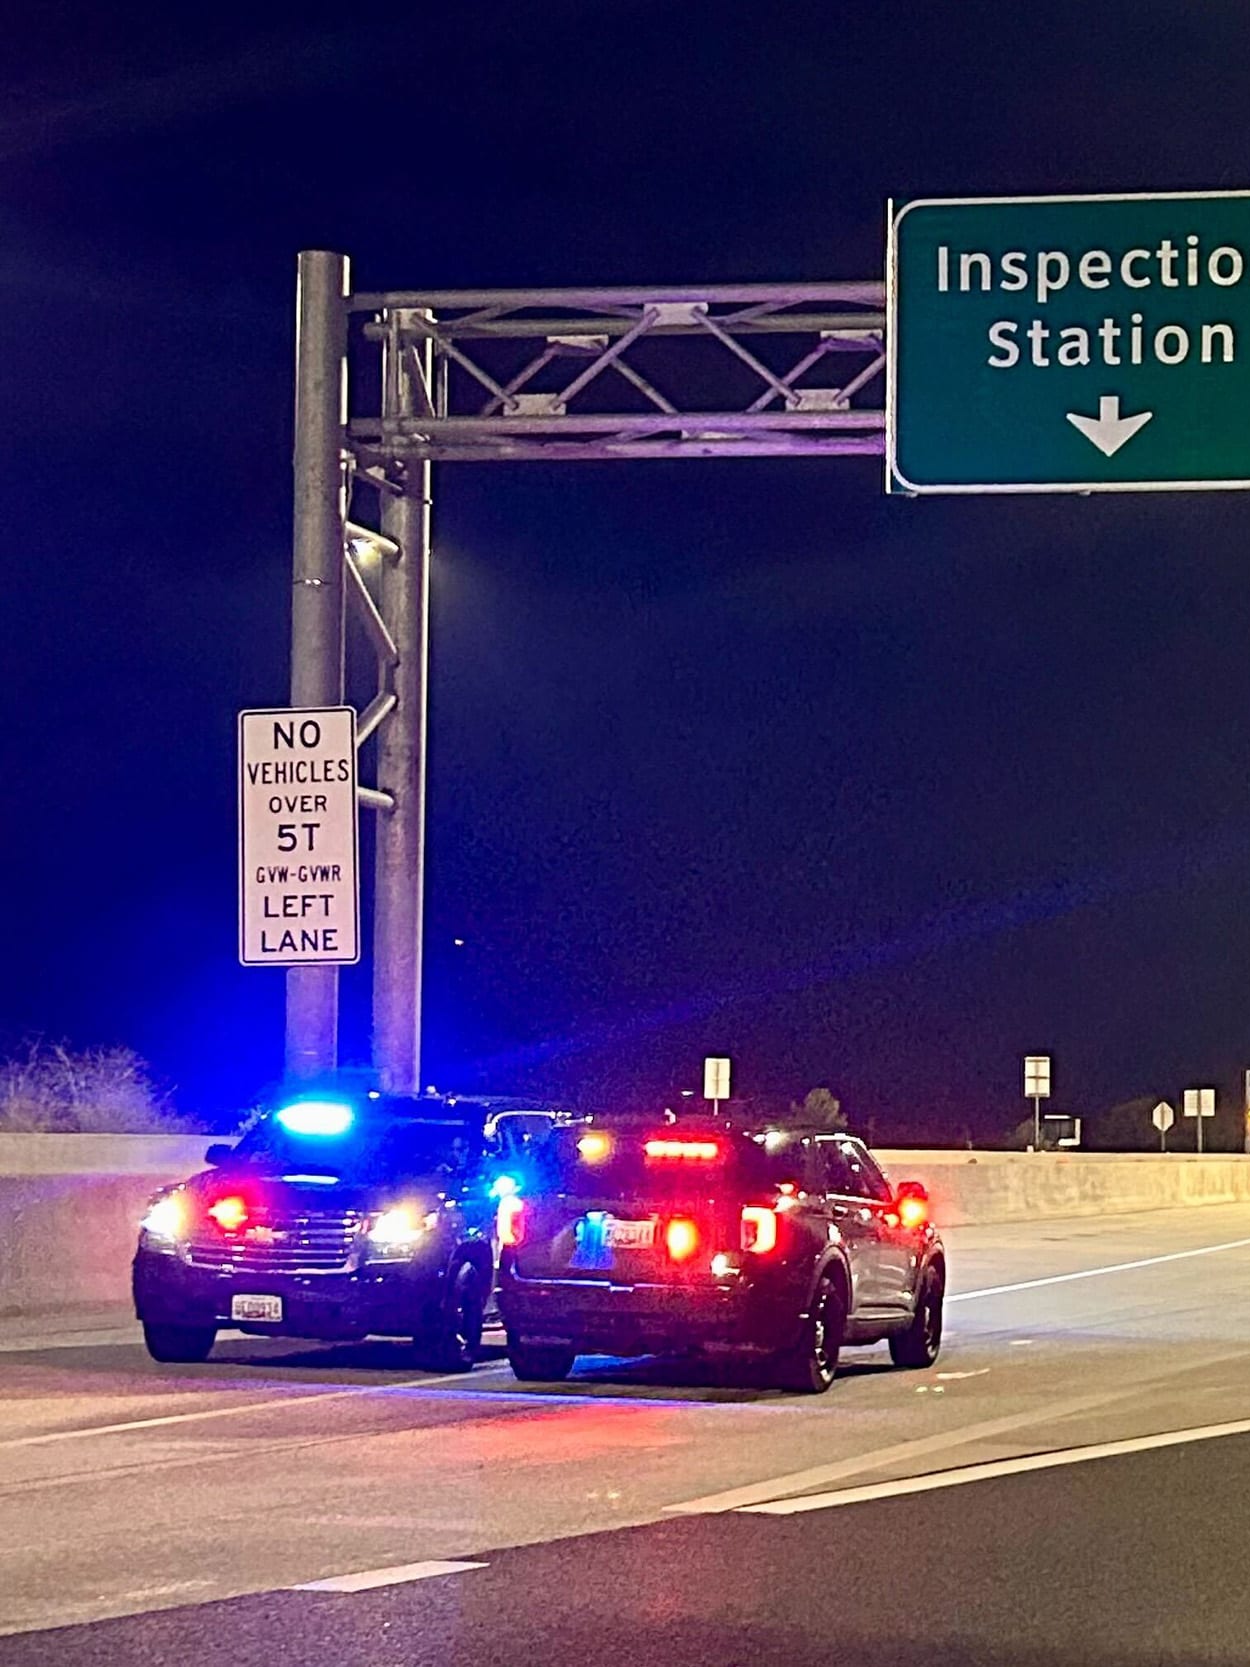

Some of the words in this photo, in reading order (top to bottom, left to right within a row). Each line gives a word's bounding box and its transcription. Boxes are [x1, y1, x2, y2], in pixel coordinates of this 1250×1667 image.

[987, 313, 1235, 368] Station
[273, 720, 321, 749] NO
[247, 759, 350, 785] VEHICLES
[268, 795, 327, 813] OVER
[277, 823, 320, 852] 5T
[256, 864, 341, 884] GVW-GVWR
[263, 894, 334, 918] LEFT
[261, 929, 338, 953] LANE
